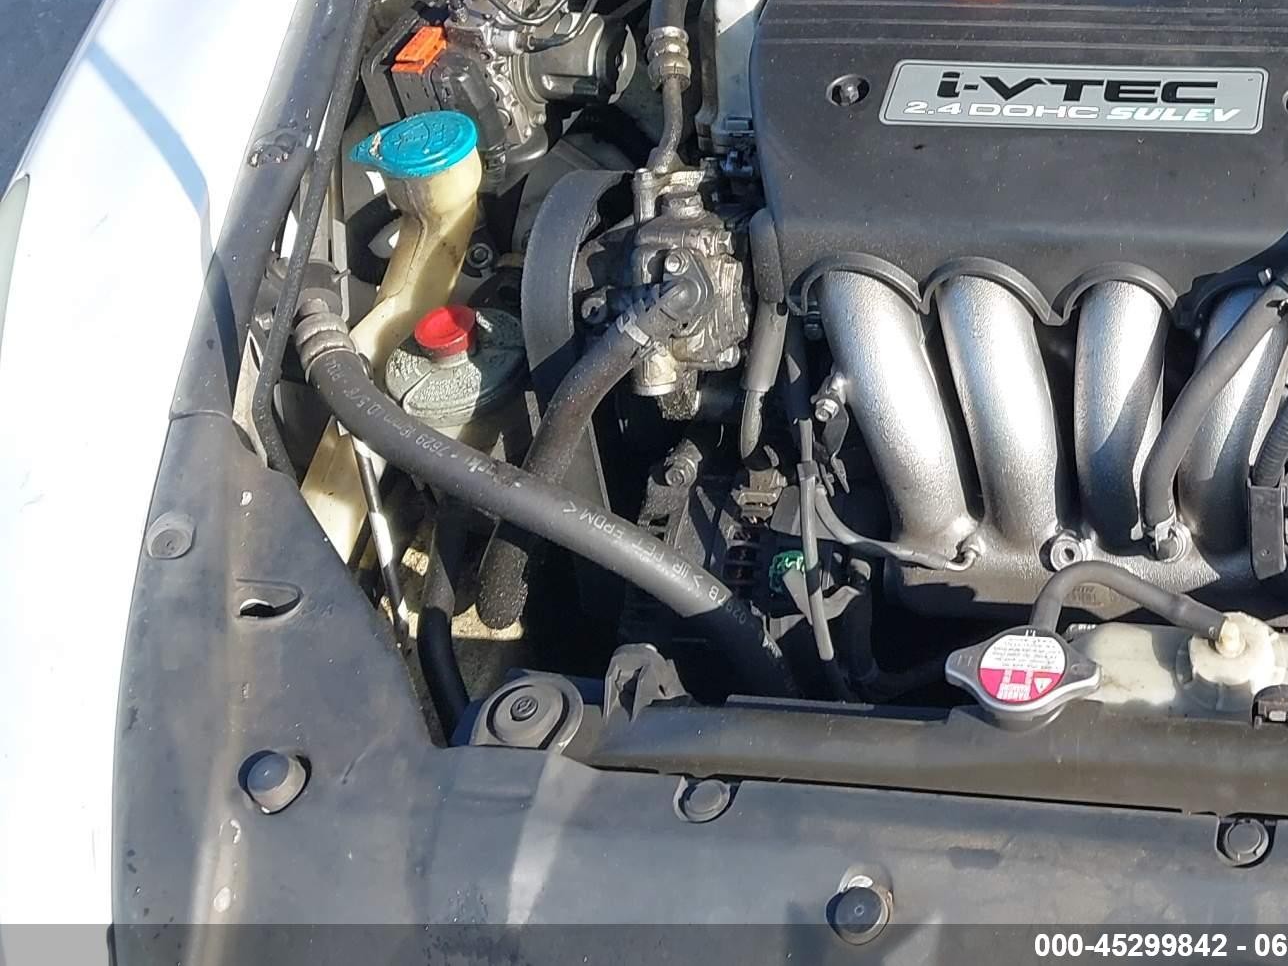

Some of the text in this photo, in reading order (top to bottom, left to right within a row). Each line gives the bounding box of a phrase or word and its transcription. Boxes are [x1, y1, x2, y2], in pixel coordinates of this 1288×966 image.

[936, 71, 1219, 105] i-VTEC
[903, 100, 1242, 123] 2.4 DOHC SULEV
